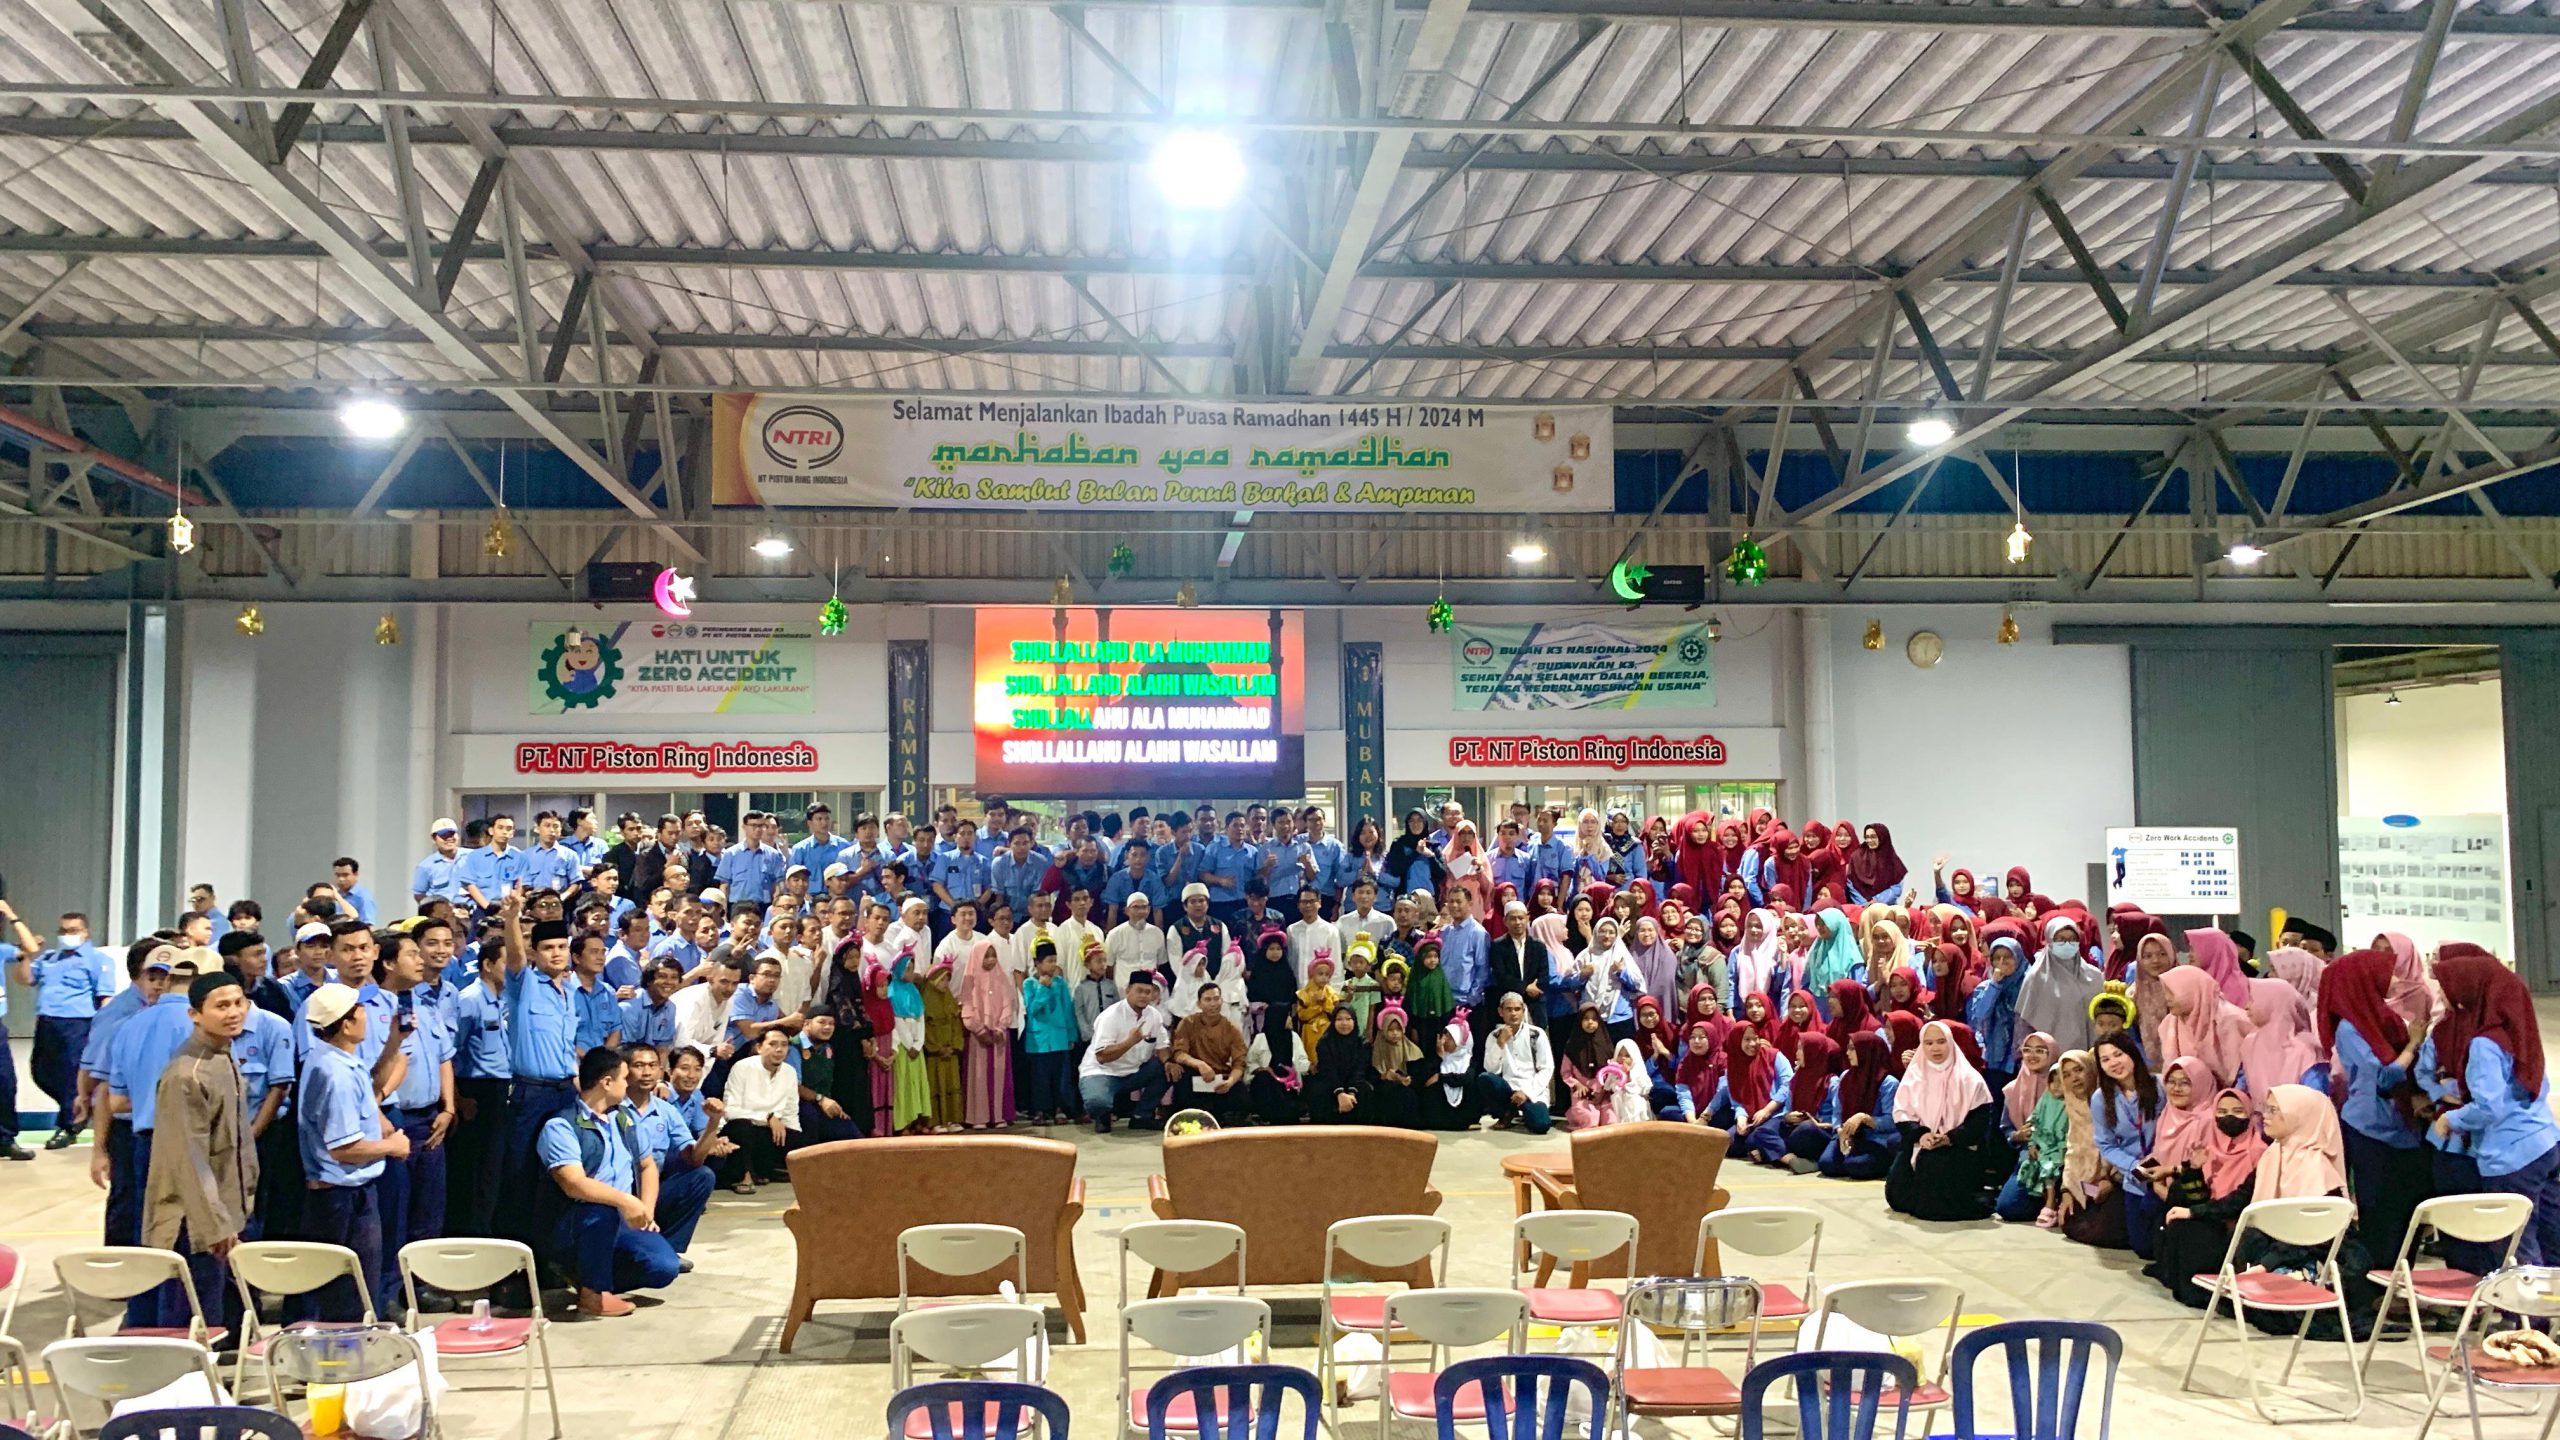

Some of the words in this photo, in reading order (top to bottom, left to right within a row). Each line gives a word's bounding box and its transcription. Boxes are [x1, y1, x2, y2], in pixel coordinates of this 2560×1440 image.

[893, 398, 973, 422] Selamat
[979, 402, 1098, 428] Menjalankan
[1104, 404, 1167, 425] Ibadah
[1173, 405, 1228, 426] Puasa
[1233, 407, 1331, 427] Ramadhan
[1339, 408, 1379, 427] 1445
[1386, 408, 1402, 427] H
[1406, 408, 1413, 427] /
[1419, 407, 1462, 427] 2024
[1468, 408, 1484, 428] M
[772, 429, 833, 446] NTRI
[1157, 448, 1229, 474] yaa
[757, 474, 767, 484] NT
[768, 474, 794, 484] PISTON
[794, 475, 812, 485] RING
[812, 475, 849, 485] INDONESIA
[976, 477, 1072, 502] Sambut
[1076, 479, 1158, 505] Bulan
[1163, 480, 1236, 503] Penuh
[1241, 481, 1329, 508] Berkah
[1333, 482, 1353, 504] &
[1354, 481, 1475, 508] Ampunan
[655, 650, 701, 665] HATI
[706, 649, 782, 665] UNTUK
[1132, 641, 1165, 663] ALA
[1167, 641, 1271, 663] MUHAMMAD
[1466, 646, 1491, 656] NTRI
[1498, 646, 1543, 655] BULAN
[1546, 646, 1563, 655] K3
[1566, 645, 1631, 655] NASIONAL
[1635, 644, 1668, 653] 2024
[638, 667, 692, 682] ZERO
[697, 667, 797, 682] ACCIDENT
[1460, 673, 1502, 682] SEHAT
[1506, 673, 1533, 681] DAN
[1536, 672, 1596, 681] SELAMAT
[1600, 672, 1645, 680] DALAM
[651, 684, 674, 692] PASTI
[676, 684, 695, 692] BISA
[1183, 673, 1277, 696] WASALLAM
[1131, 707, 1165, 730] ALA
[1167, 707, 1270, 730] MUHAMMAD
[521, 748, 551, 767] PT.
[558, 748, 587, 767] NT
[592, 747, 657, 767] Piston
[663, 746, 710, 772] Ring
[715, 746, 813, 767] Indonesia
[1183, 740, 1278, 763] WASALLAM
[1454, 742, 1483, 760] PT.
[1489, 742, 1514, 760] NT
[1520, 741, 1580, 760] Piston
[1585, 740, 1626, 763] Ring
[1632, 740, 1722, 760] Indonesia
[2145, 834, 2162, 842] Zero
[2163, 834, 2181, 842] Work
[2183, 834, 2219, 842] Accidents
